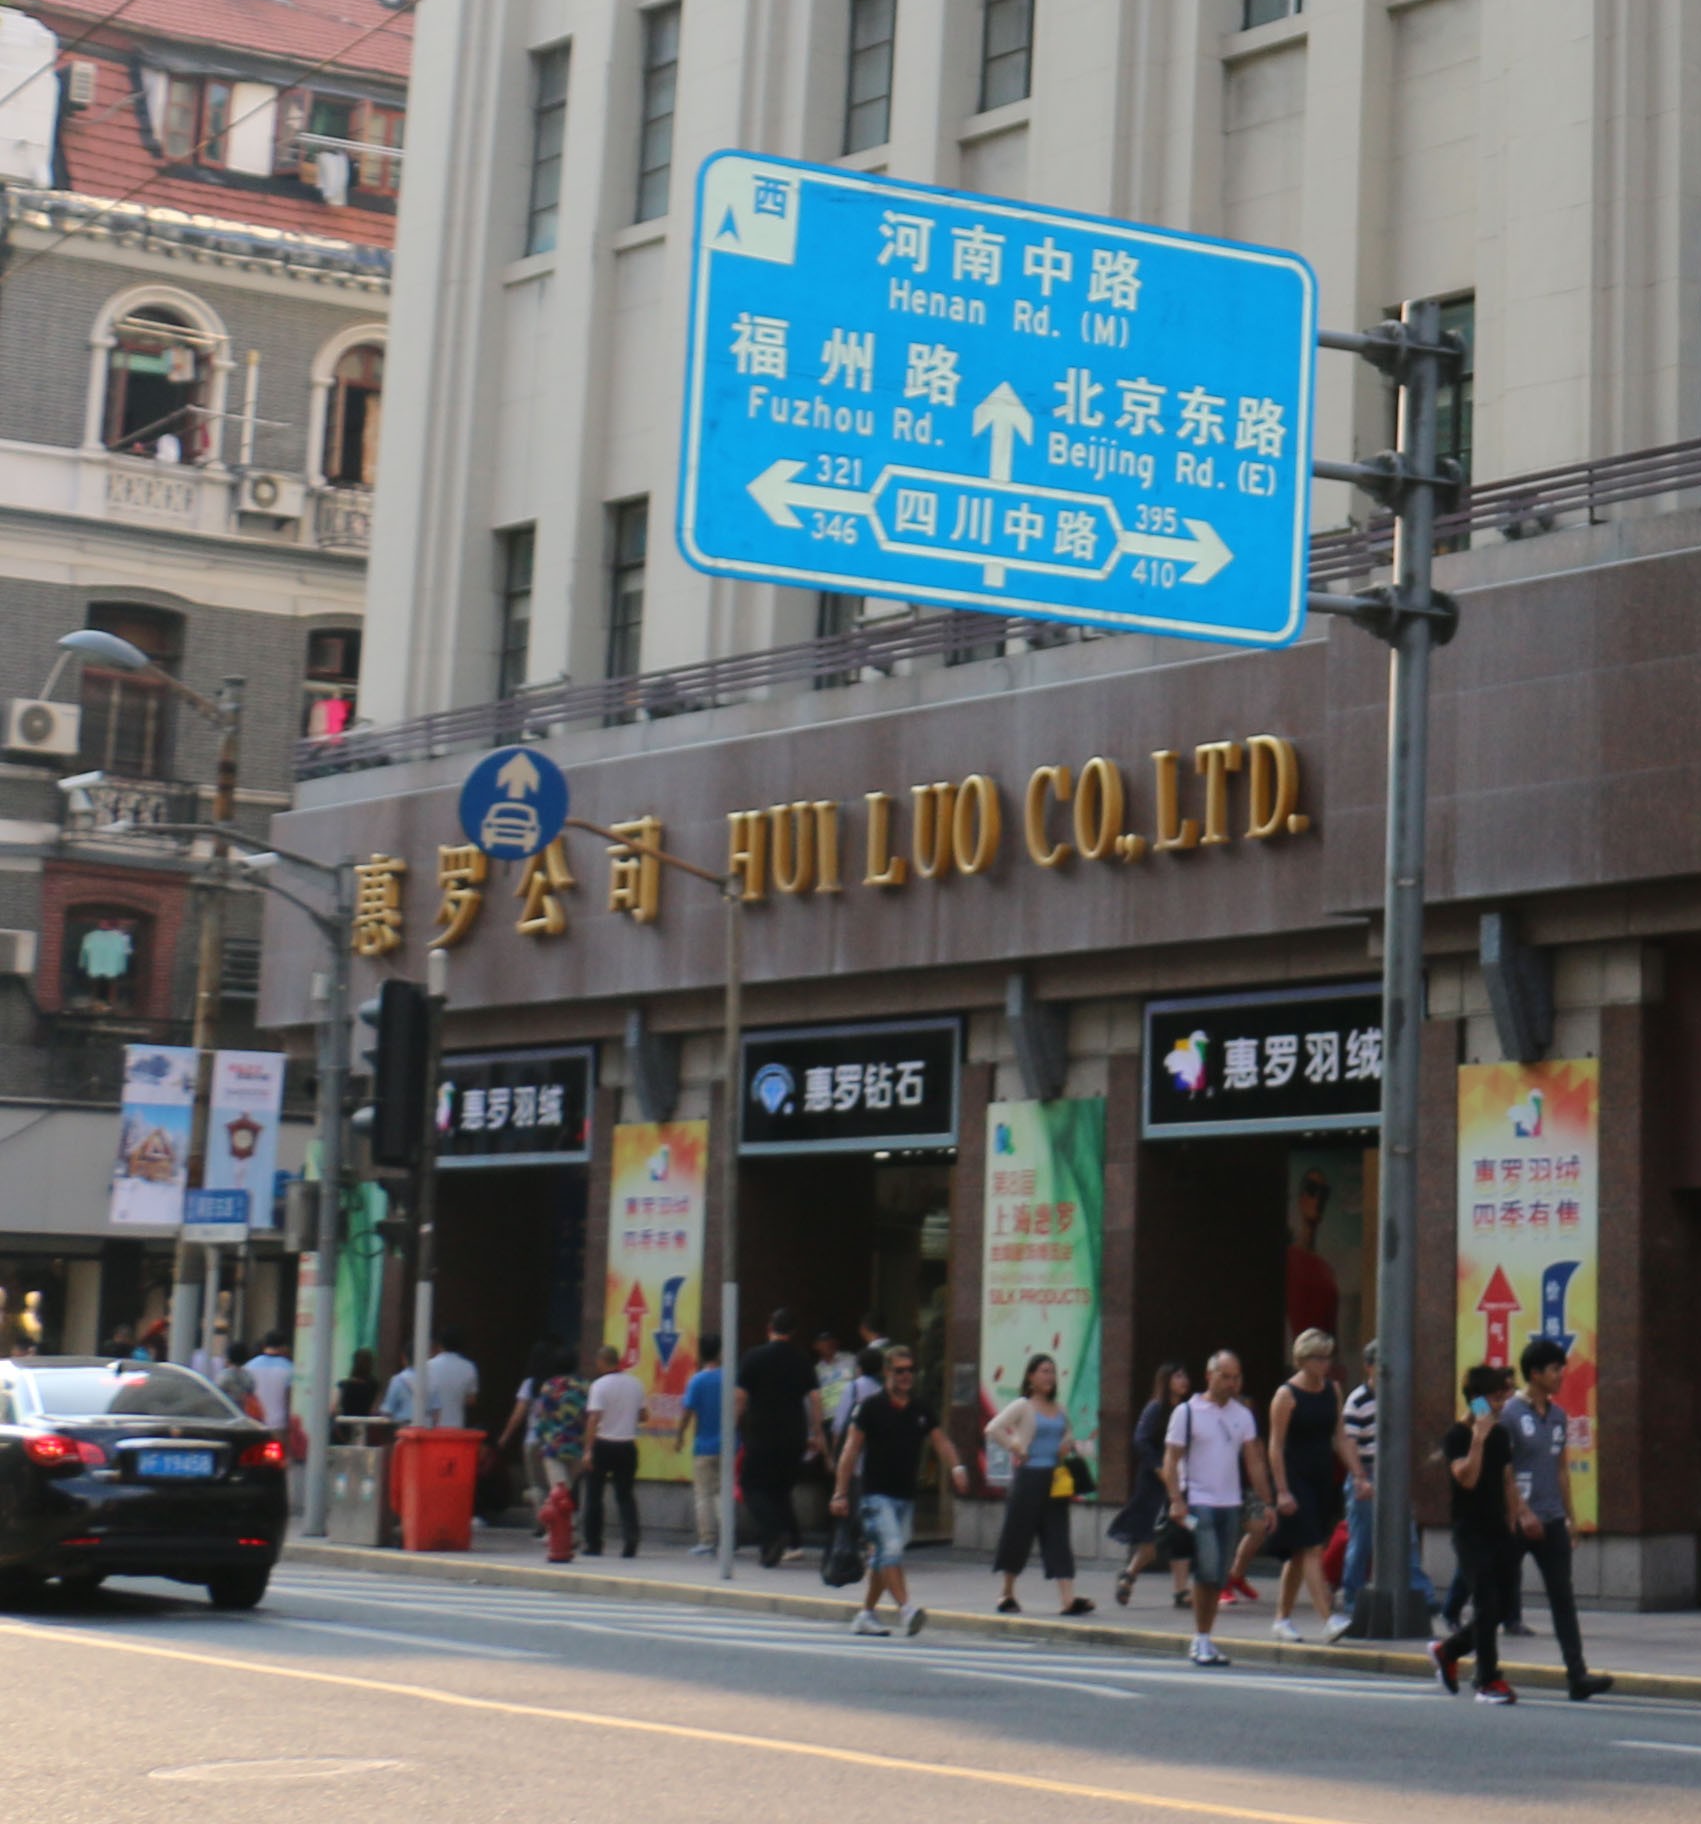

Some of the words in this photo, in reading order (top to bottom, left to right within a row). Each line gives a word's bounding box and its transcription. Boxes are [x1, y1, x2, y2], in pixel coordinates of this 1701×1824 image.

[753, 173, 790, 219] 西
[877, 209, 1143, 312] 河南中路
[889, 277, 986, 326] Henan
[1013, 306, 1060, 338] Rd.
[1081, 310, 1130, 349] (M)
[729, 312, 963, 408] 福州路
[747, 385, 875, 438] Fuzhou
[893, 407, 944, 447] Rd.
[1053, 367, 1288, 459] 北京东路
[816, 454, 863, 486] 321
[1048, 429, 1155, 486] Beijing
[1176, 452, 1226, 491] Rd.
[1238, 460, 1278, 499] (E)
[811, 513, 858, 545] 346
[895, 487, 1099, 563] 四川中路
[1135, 504, 1178, 535] 395
[1132, 558, 1177, 589] 410
[726, 800, 839, 902] HUI
[863, 774, 999, 886] LUO
[353, 814, 664, 957] 惠罗公司
[803, 1061, 925, 1113] 惠罗钻石
[1222, 1026, 1383, 1091] 惠罗羽绒
